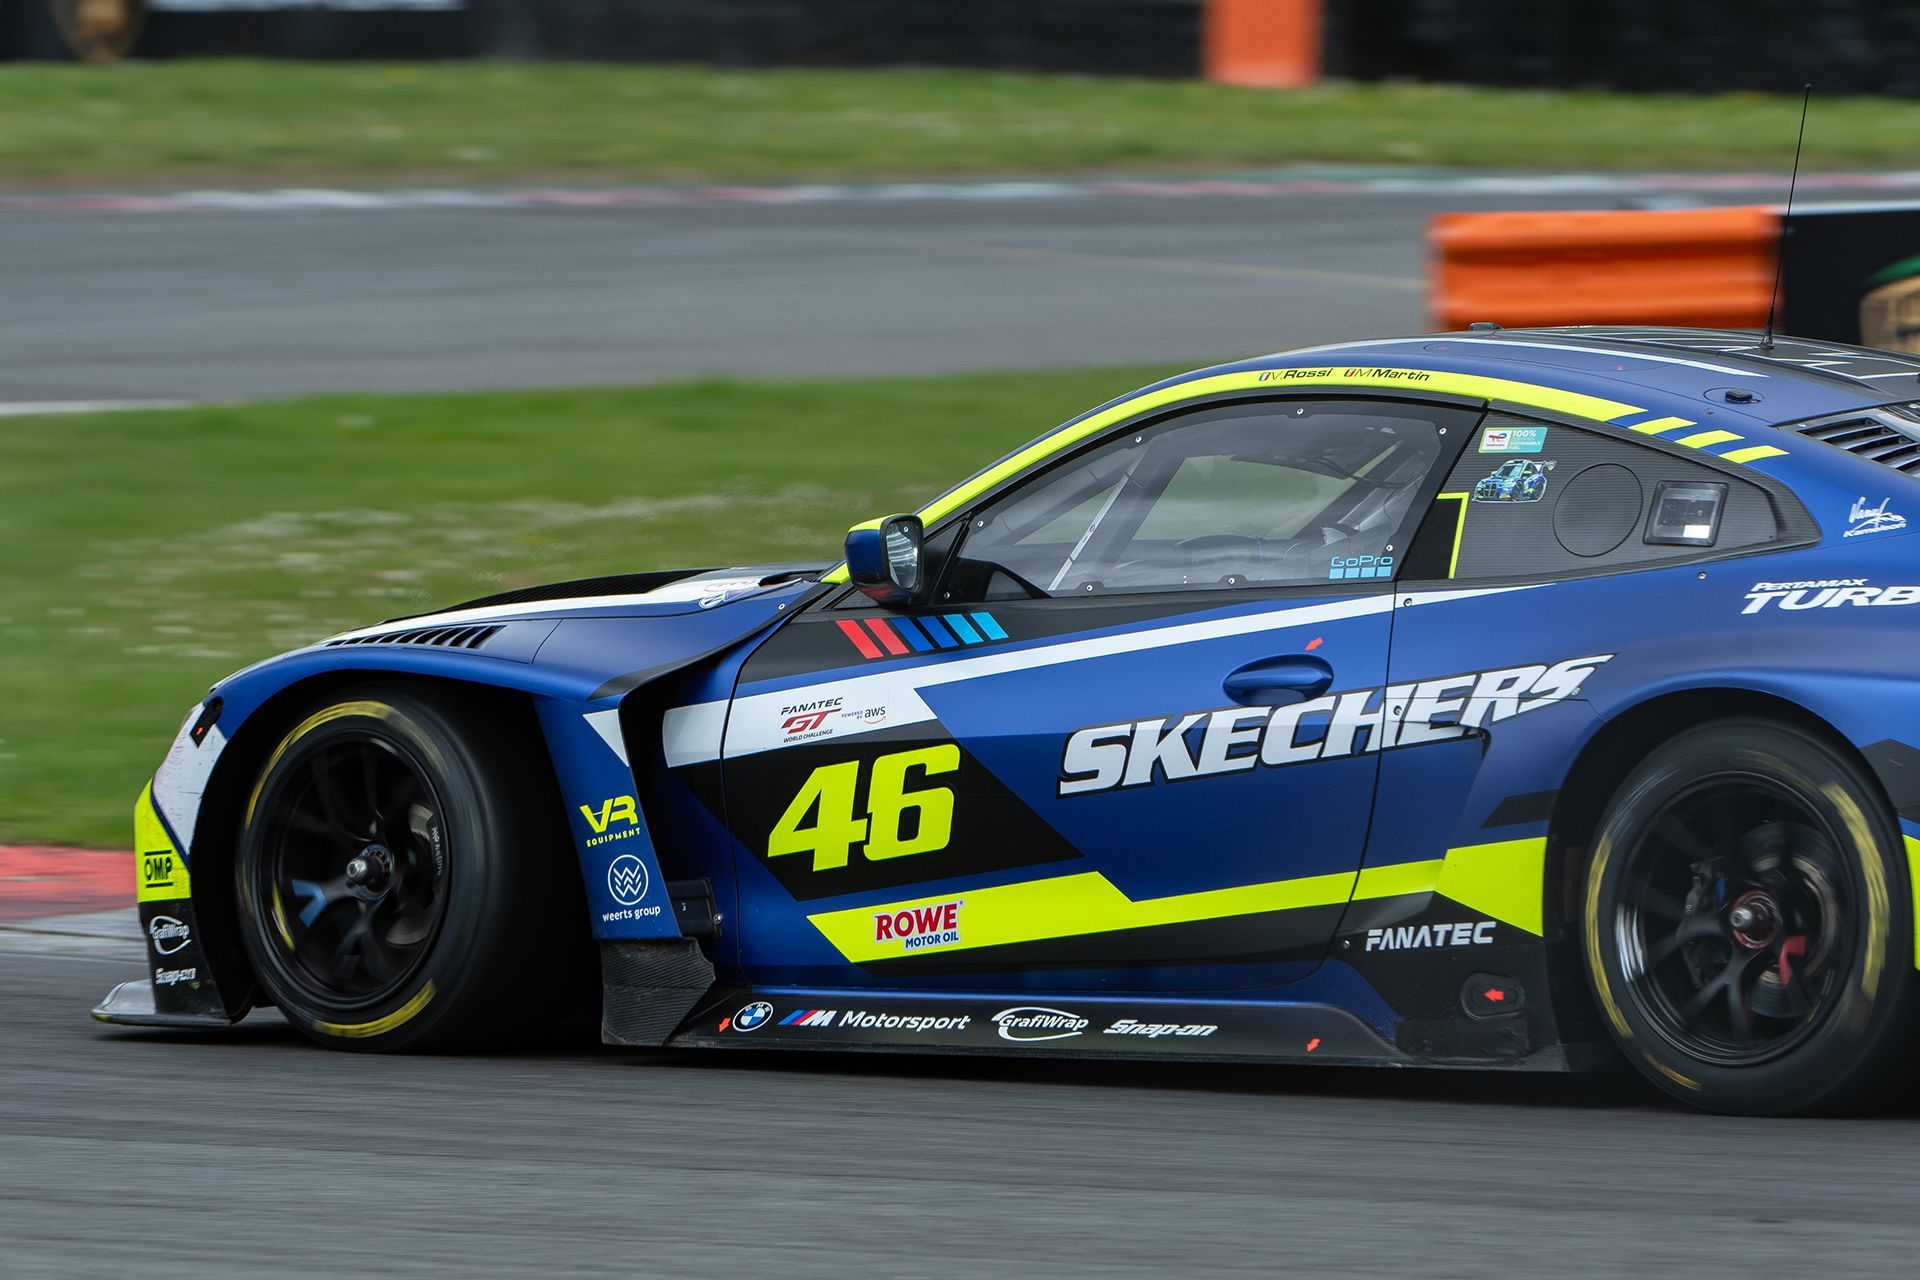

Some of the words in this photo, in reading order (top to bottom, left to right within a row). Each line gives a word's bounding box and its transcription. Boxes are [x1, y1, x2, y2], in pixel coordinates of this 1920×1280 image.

[1271, 368, 1333, 380] V.Rossi
[1331, 555, 1393, 567] GoPro
[1751, 578, 1868, 592] PERTAMAX
[781, 697, 843, 715] FANATEC
[864, 706, 886, 718] aws
[781, 708, 842, 734] GT
[1060, 654, 1615, 796] SKECHERS
[783, 735, 803, 743] WORLD
[803, 729, 833, 740] CHALLENGE
[580, 795, 639, 833] VR
[767, 743, 961, 872] 46
[586, 827, 640, 847] EQUIPMENT
[144, 856, 172, 881] OMP
[602, 908, 633, 922] weerts
[635, 905, 661, 920] group
[875, 903, 958, 941] ROWE
[905, 934, 940, 949] MOTOR
[943, 931, 959, 941] OIL
[1365, 921, 1497, 951] FANATEC
[838, 1010, 971, 1032] Motorsport
[999, 1014, 1090, 1031] GrafiWrap
[1102, 1019, 1218, 1039] Snap-on
